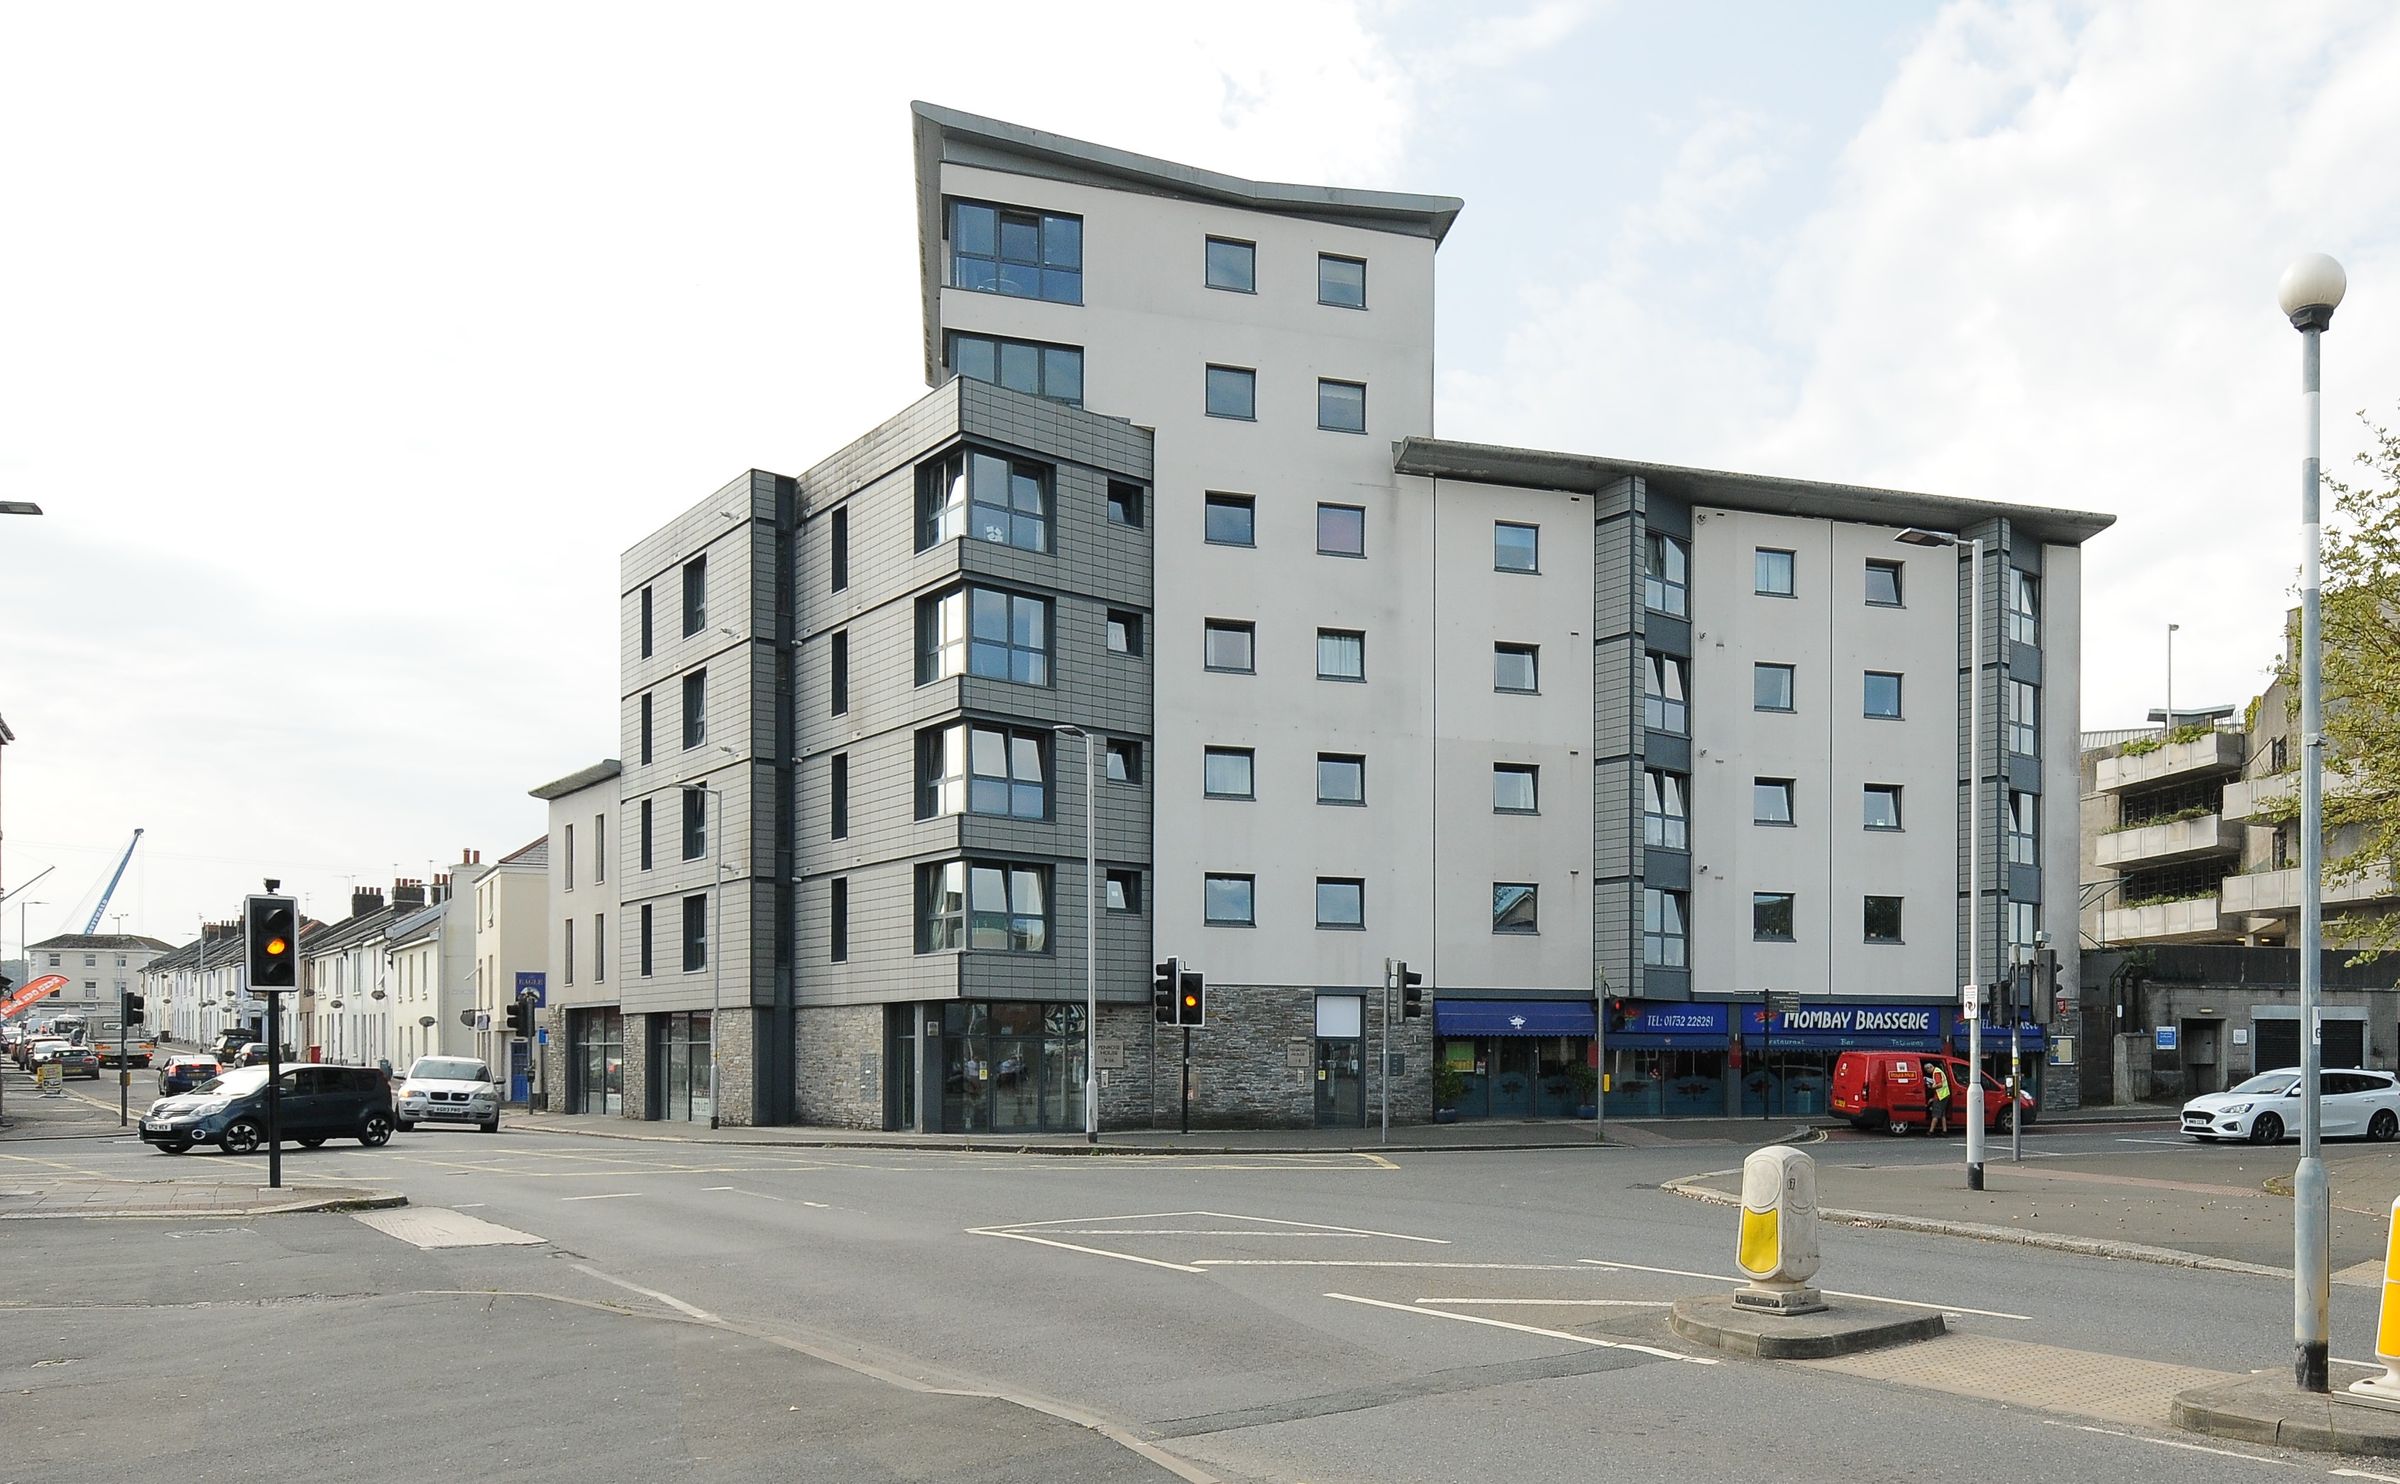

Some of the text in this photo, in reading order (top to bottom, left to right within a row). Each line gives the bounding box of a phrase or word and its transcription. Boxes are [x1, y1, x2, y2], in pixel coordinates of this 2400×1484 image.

[1647, 1015, 1662, 1027] TEL:
[1664, 1015, 1686, 1027] 01752
[1784, 1010, 1930, 1030] MOMBAY BRASSERIE
